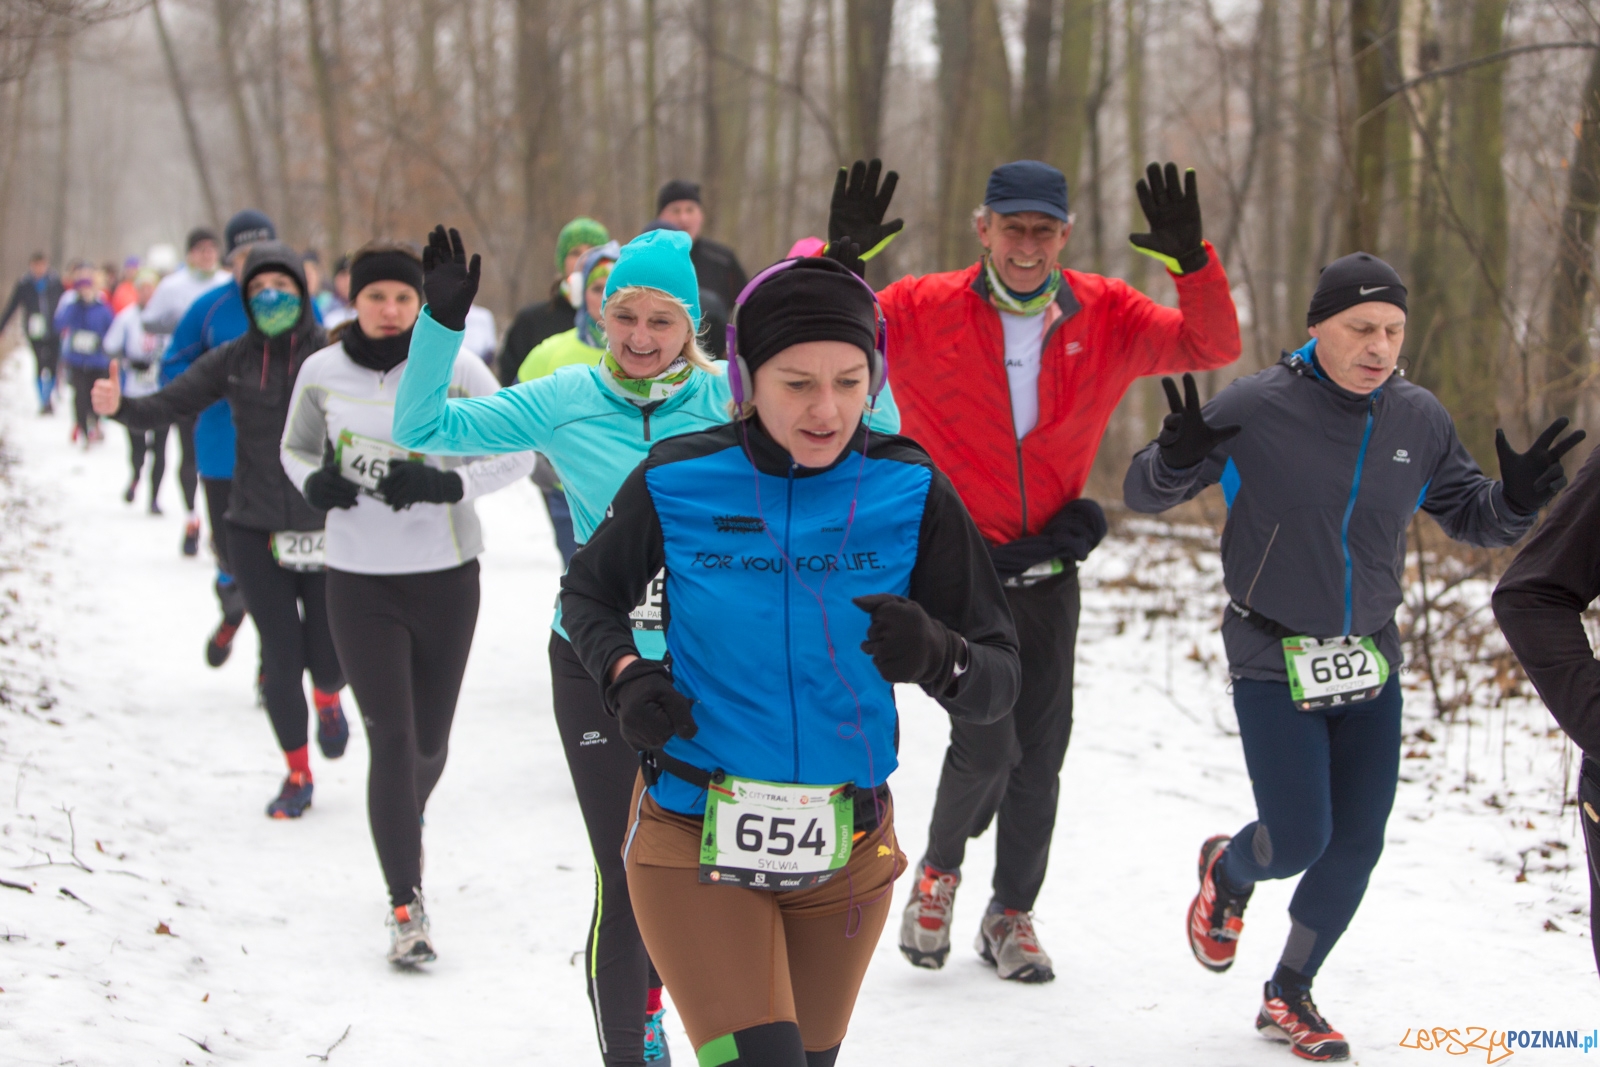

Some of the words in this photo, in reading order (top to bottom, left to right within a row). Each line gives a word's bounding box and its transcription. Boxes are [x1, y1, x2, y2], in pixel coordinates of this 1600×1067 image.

[691, 552, 732, 570] FOR
[741, 556, 784, 574] YOU
[796, 554, 839, 573] FOR
[842, 551, 887, 572] LIFE.
[1311, 649, 1372, 684] 682
[735, 813, 826, 856] 654
[837, 824, 848, 859] Poznań
[757, 858, 799, 871] SYLWIA
